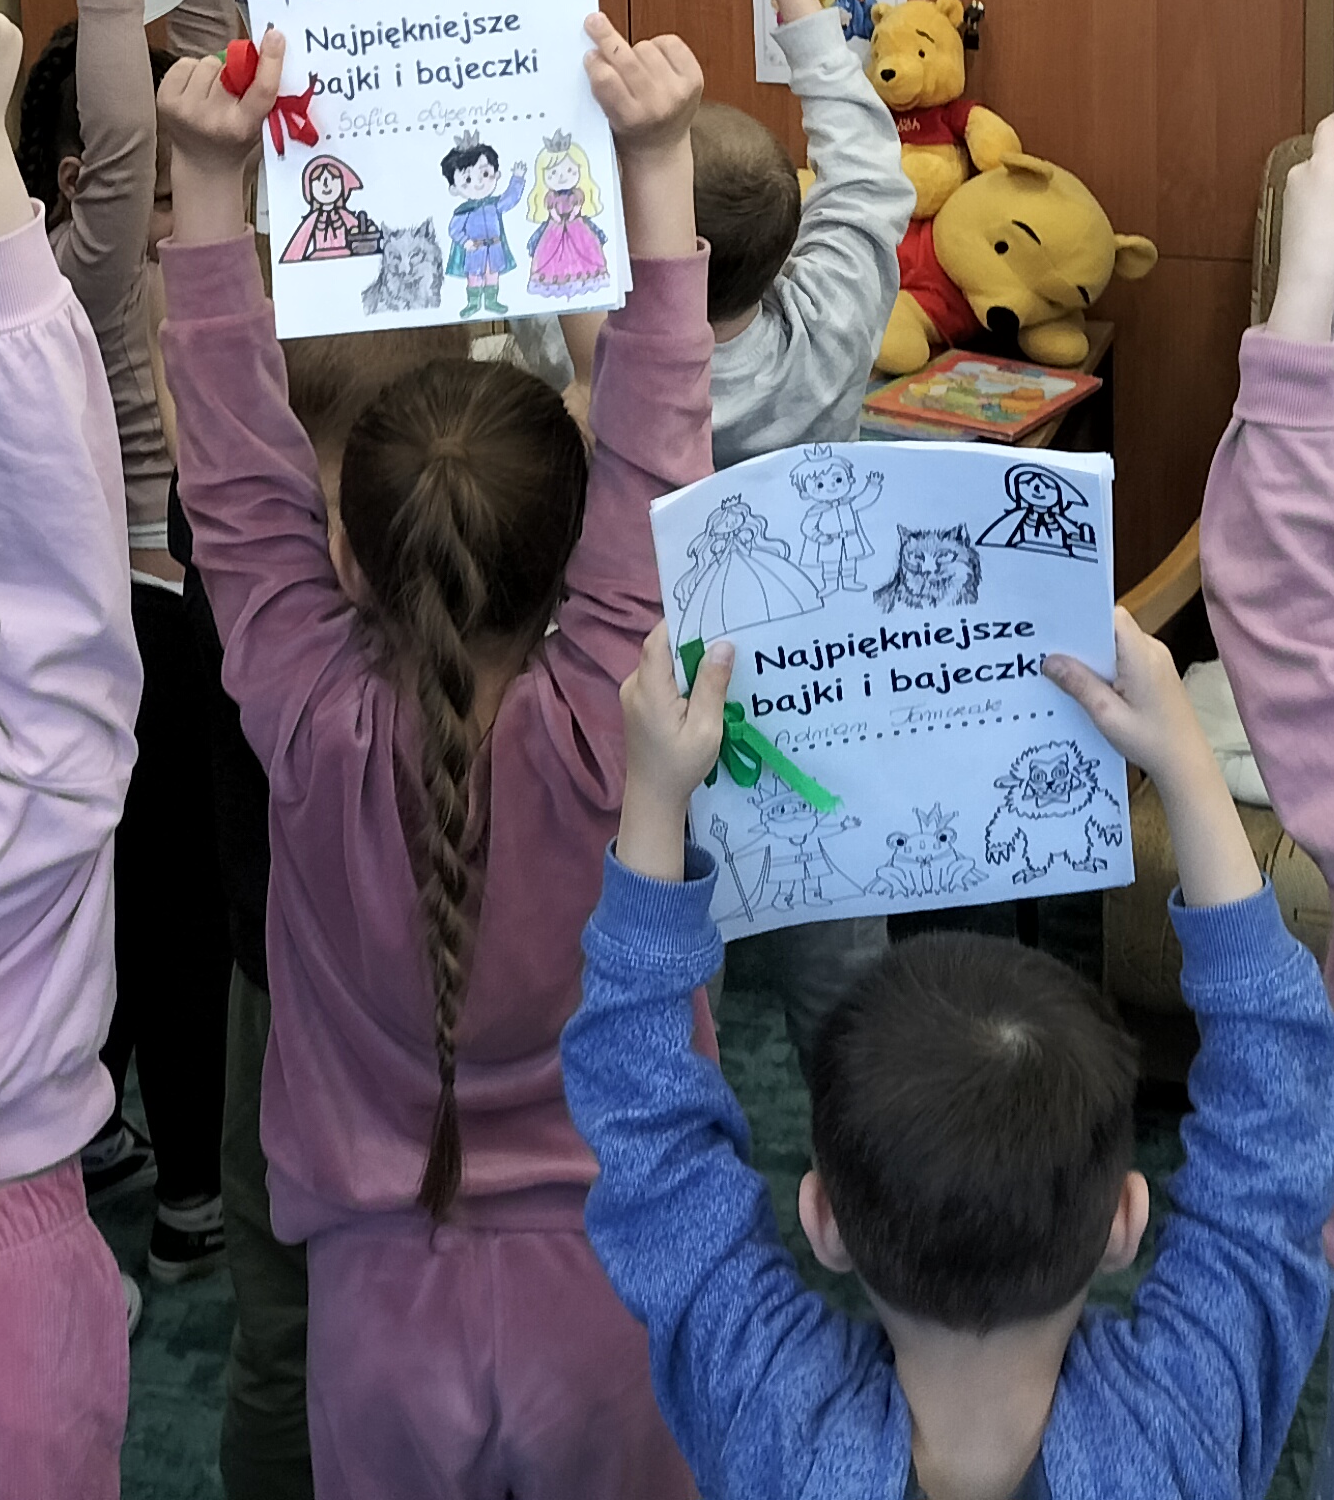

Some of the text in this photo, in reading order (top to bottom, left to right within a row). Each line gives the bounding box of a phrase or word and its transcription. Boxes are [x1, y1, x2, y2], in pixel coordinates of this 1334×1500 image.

[305, 12, 521, 56] Najpiękniejsze
[396, 63, 402, 87] i
[417, 48, 539, 89] bajeczki
[754, 618, 1035, 675] Najpiękniejsze
[751, 677, 843, 718] bajki
[863, 673, 871, 697] i
